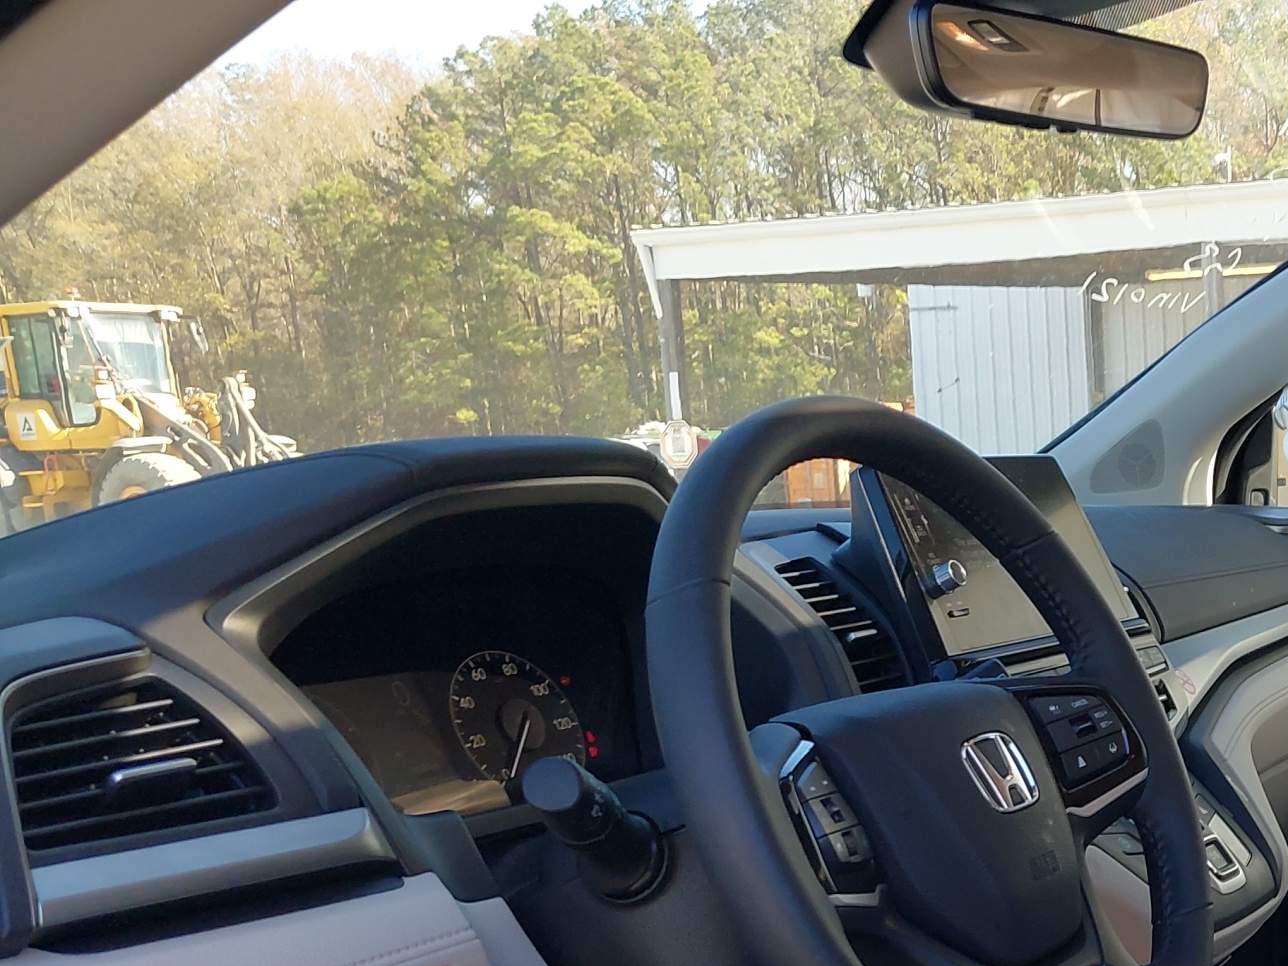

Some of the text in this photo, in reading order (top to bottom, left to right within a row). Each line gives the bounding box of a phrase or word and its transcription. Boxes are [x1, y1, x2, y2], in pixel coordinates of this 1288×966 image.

[472, 667, 487, 681] 60
[502, 663, 518, 676] 80
[530, 684, 549, 696] 100
[459, 697, 475, 709] 40
[553, 717, 572, 730] 120
[470, 734, 486, 748] 20
